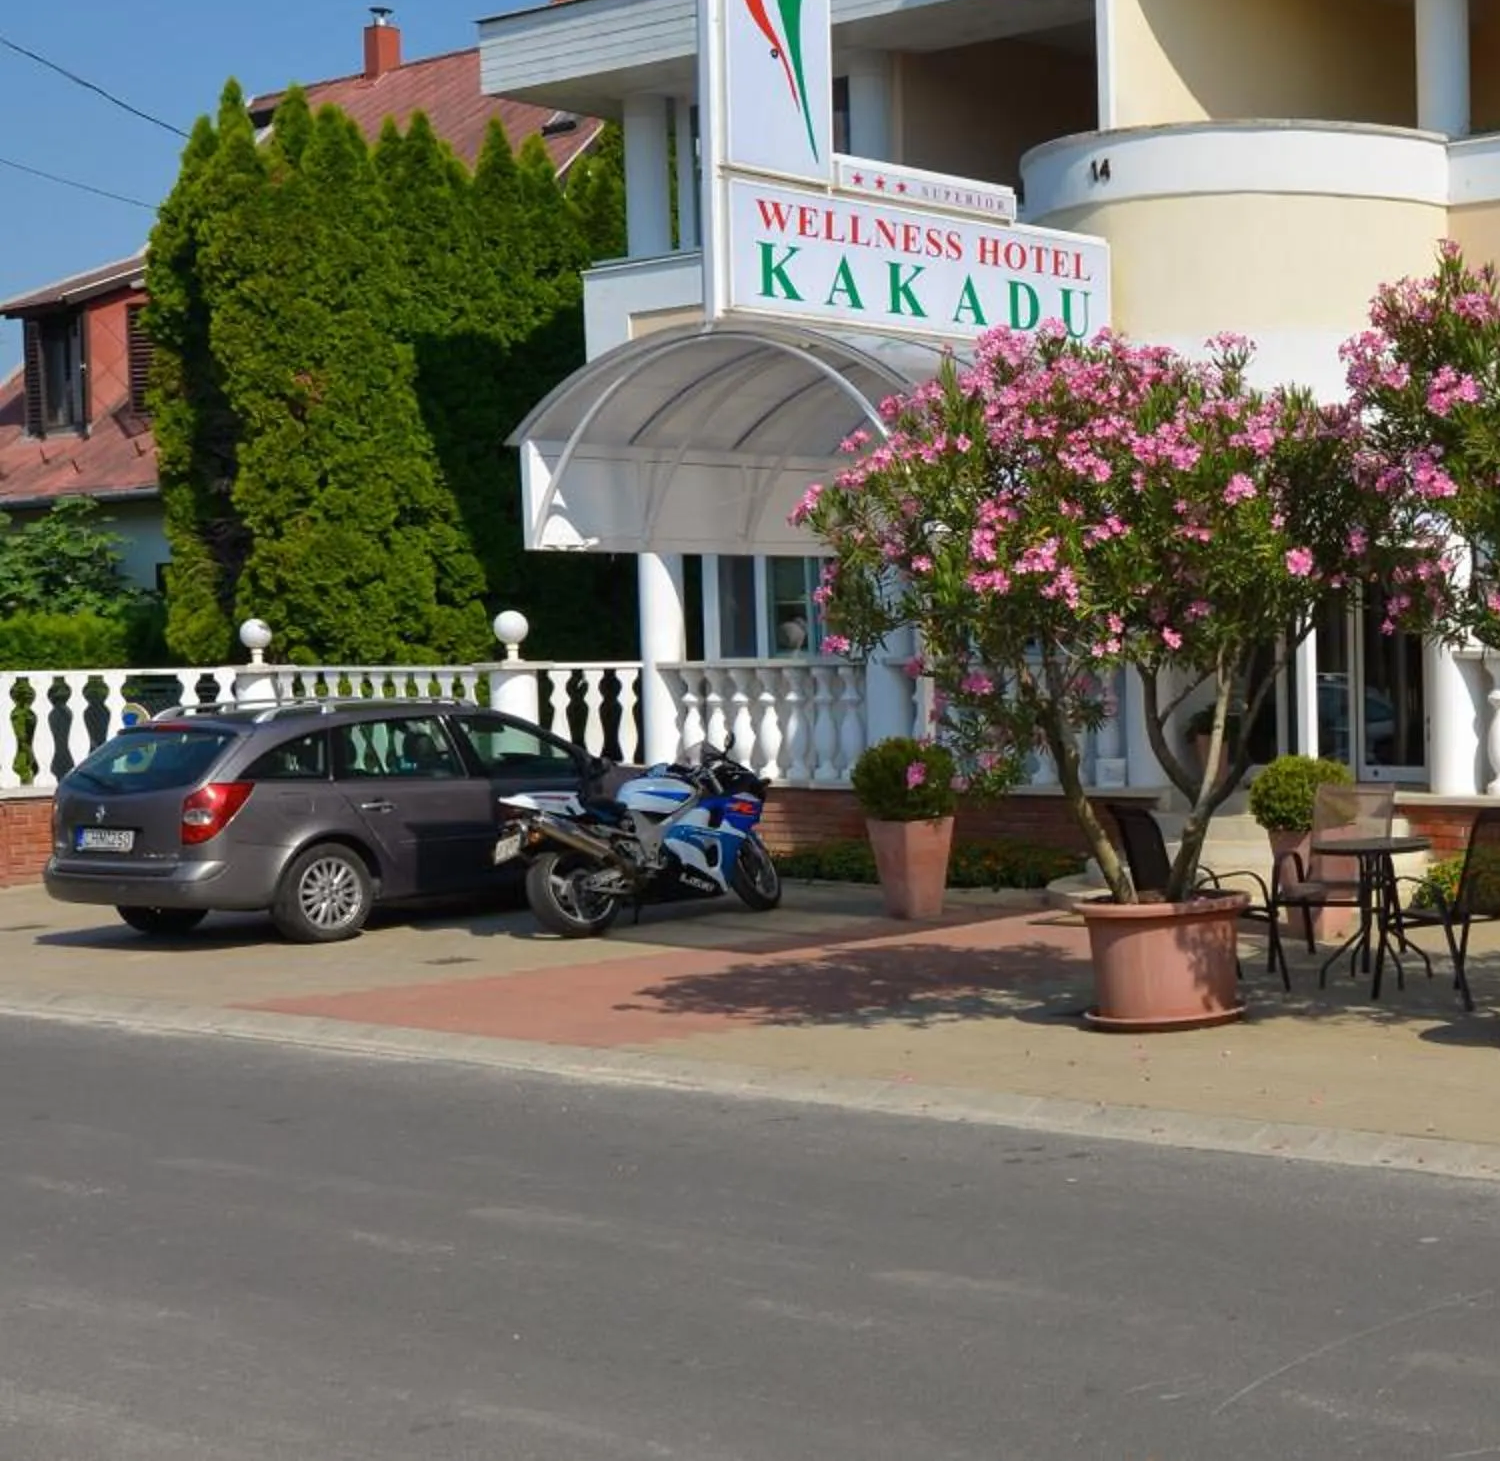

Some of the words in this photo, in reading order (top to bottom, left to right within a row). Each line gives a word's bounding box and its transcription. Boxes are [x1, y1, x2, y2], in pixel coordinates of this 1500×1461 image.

[1090, 158, 1112, 184] 14
[756, 199, 964, 261] WELLNESS
[979, 236, 1092, 282] HOTEL
[756, 241, 1092, 339] KAKADU
